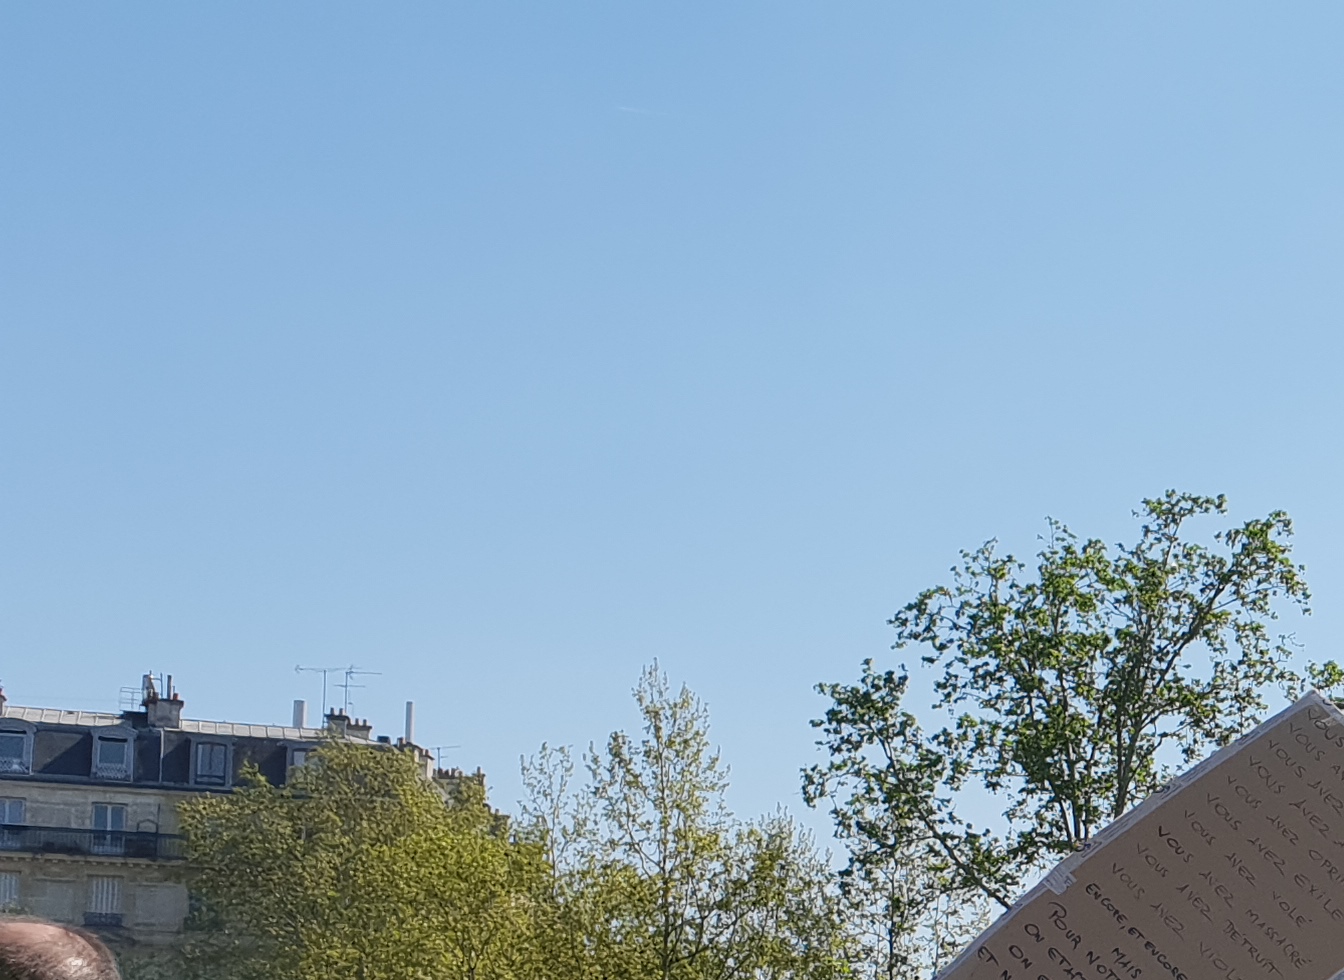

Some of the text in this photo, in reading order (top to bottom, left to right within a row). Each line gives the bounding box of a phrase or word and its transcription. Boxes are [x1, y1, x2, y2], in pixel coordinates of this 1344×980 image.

[1288, 721, 1326, 762] VOUS
[1226, 774, 1262, 809] VOUS
[1264, 814, 1299, 846] AVEZ
[1248, 754, 1286, 794] VOUS
[1287, 798, 1330, 839] AVEZ
[1267, 738, 1307, 779] VOUS
[1305, 779, 1344, 818] AVEZ
[1157, 824, 1195, 864] VOUS
[1197, 869, 1234, 909] AVEZ
[1183, 808, 1217, 846] VOUS
[1223, 851, 1256, 888] AVEZ
[1206, 791, 1242, 831] VOUS
[1245, 836, 1286, 877] AVEZ
[1111, 861, 1146, 900] VOUS
[1148, 901, 1185, 941] AVEZ
[1135, 841, 1169, 878] VOUS
[1174, 883, 1213, 923] AVEZ
[976, 944, 1000, 967] ET
[1007, 943, 1033, 970] ON
[1022, 922, 1046, 944] ON
[1046, 900, 1082, 951] POUR
[1126, 925, 1146, 940] ET
[1109, 946, 1143, 980] MAIS
